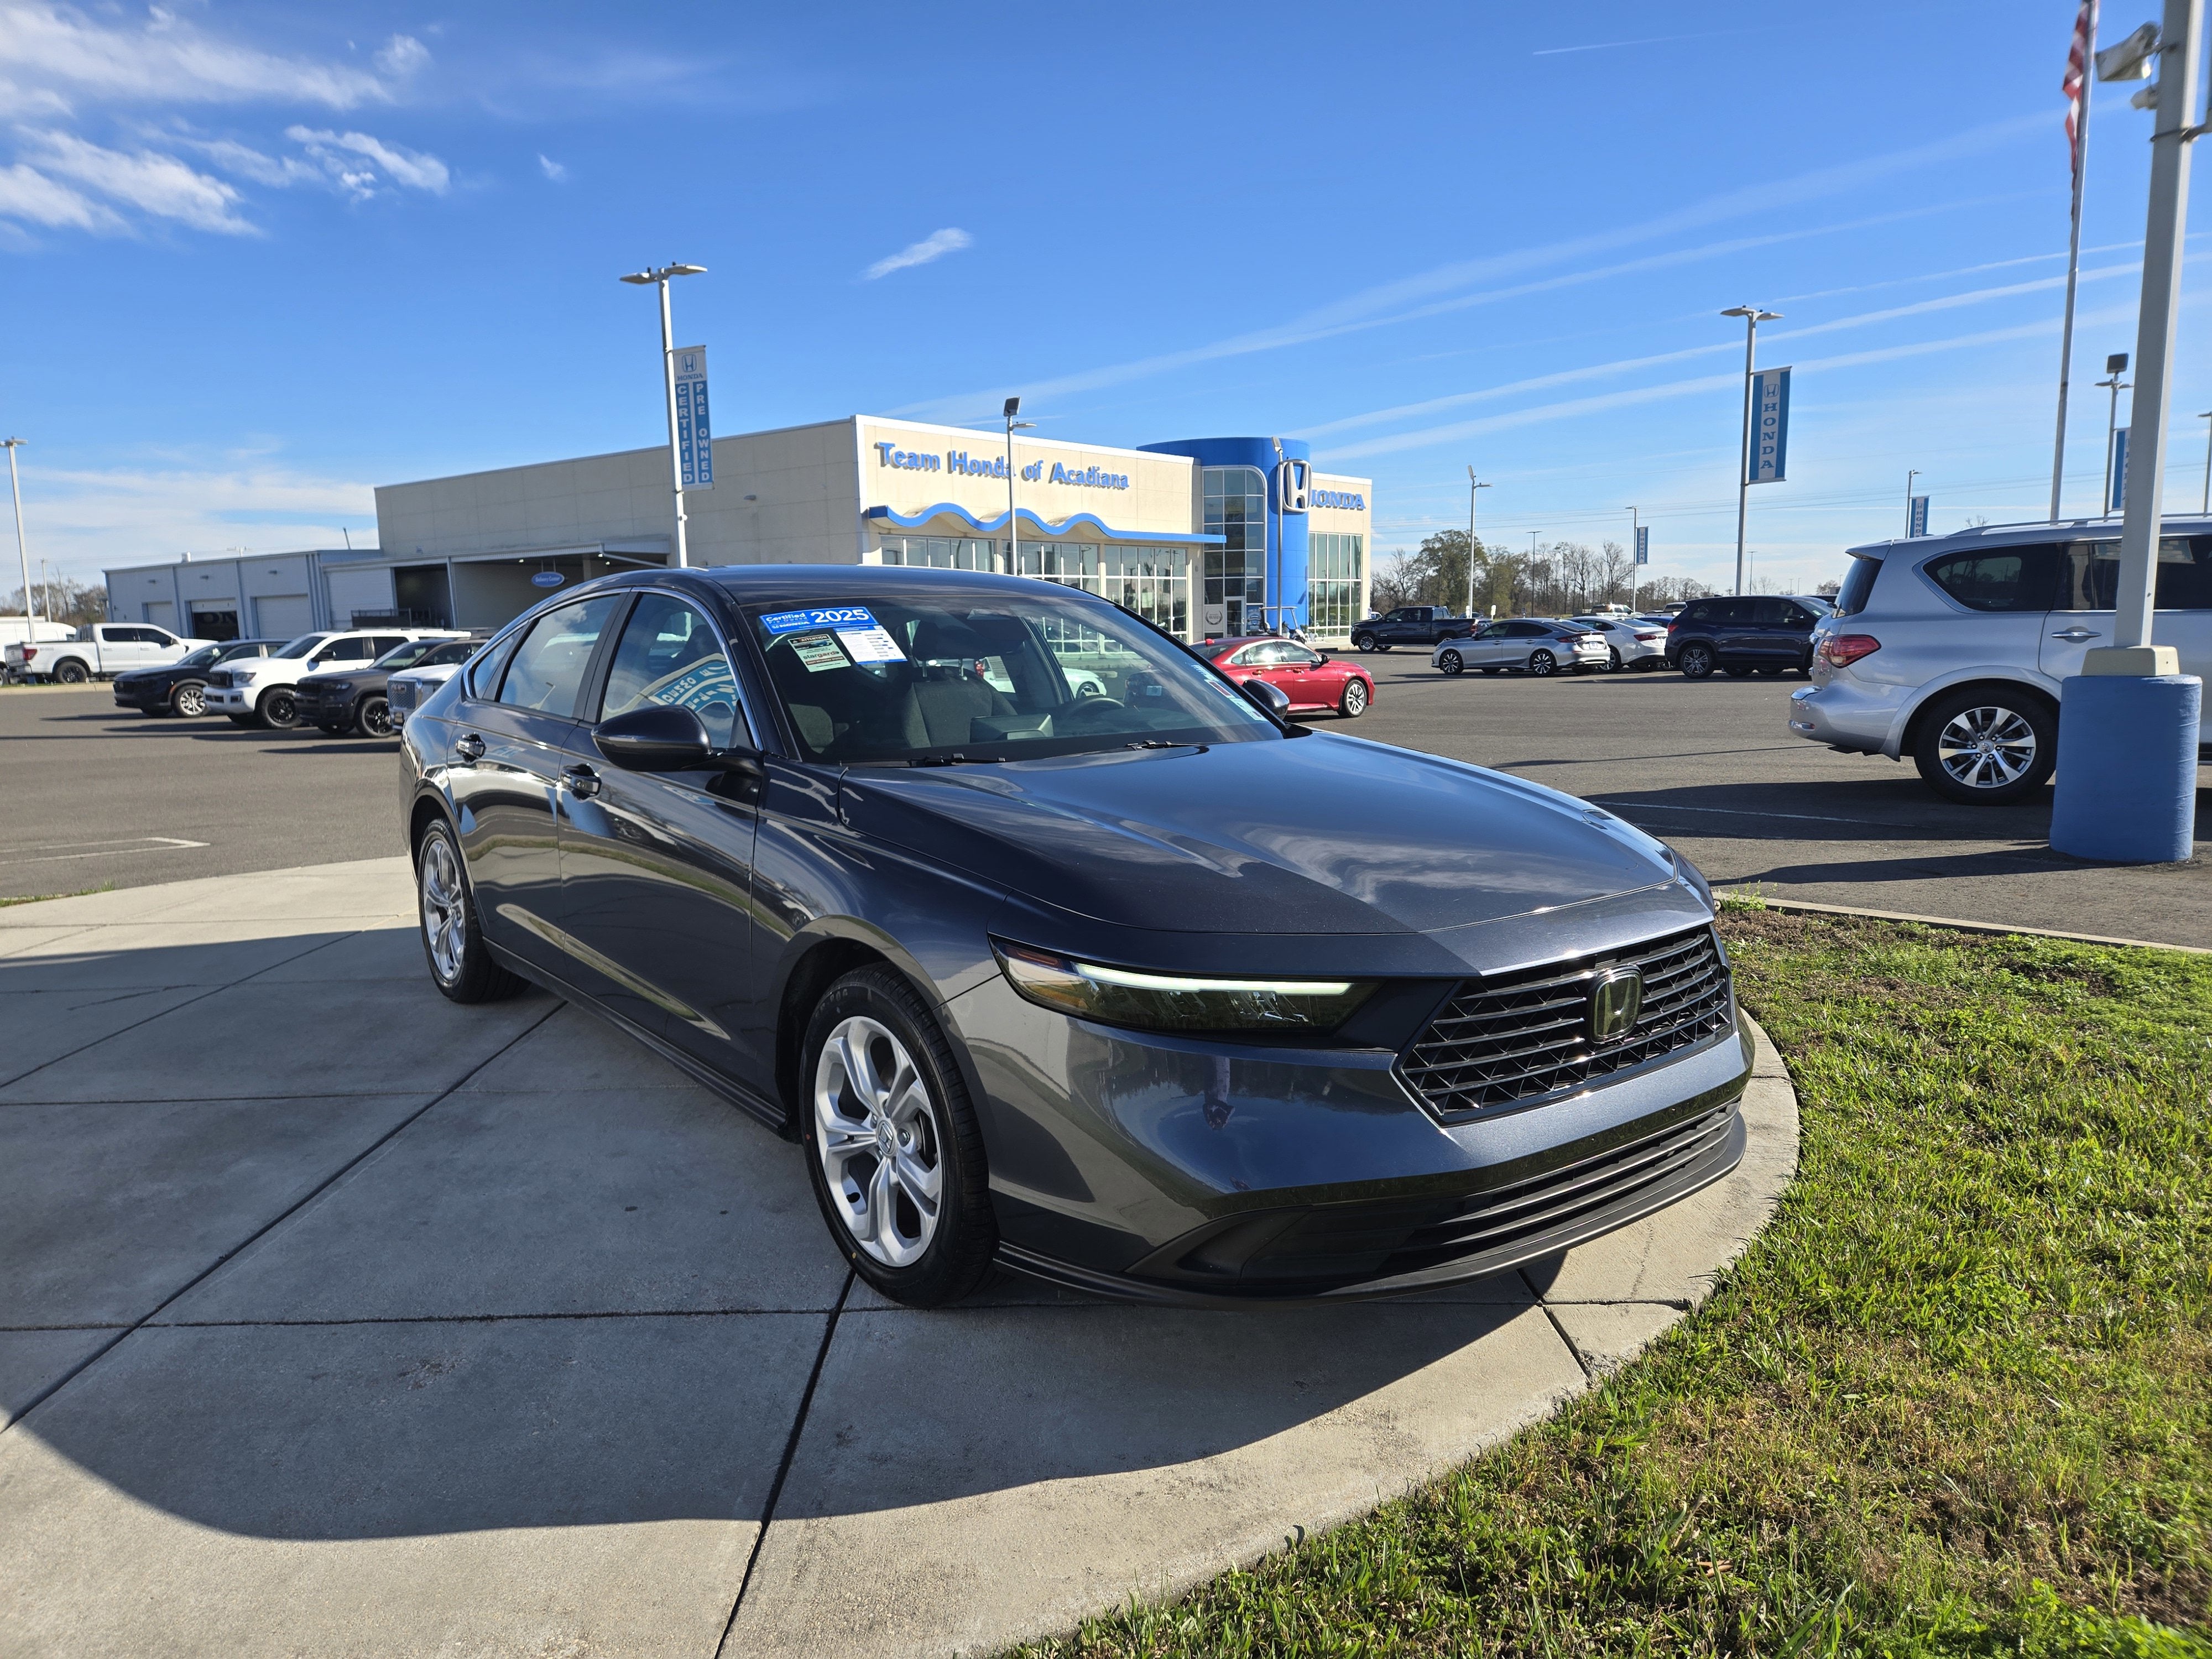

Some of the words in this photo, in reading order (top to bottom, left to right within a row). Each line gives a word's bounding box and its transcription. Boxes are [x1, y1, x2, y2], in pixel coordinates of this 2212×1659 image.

[696, 383, 706, 415] PRE
[677, 385, 693, 483] CERTIFIED
[698, 428, 710, 481] OWNED
[1760, 403, 1778, 469] HONDA
[876, 441, 941, 471] Team
[1024, 460, 1044, 480] of
[1051, 462, 1129, 489] Acadiana
[766, 613, 806, 622] Certified
[810, 609, 869, 623] 2025
